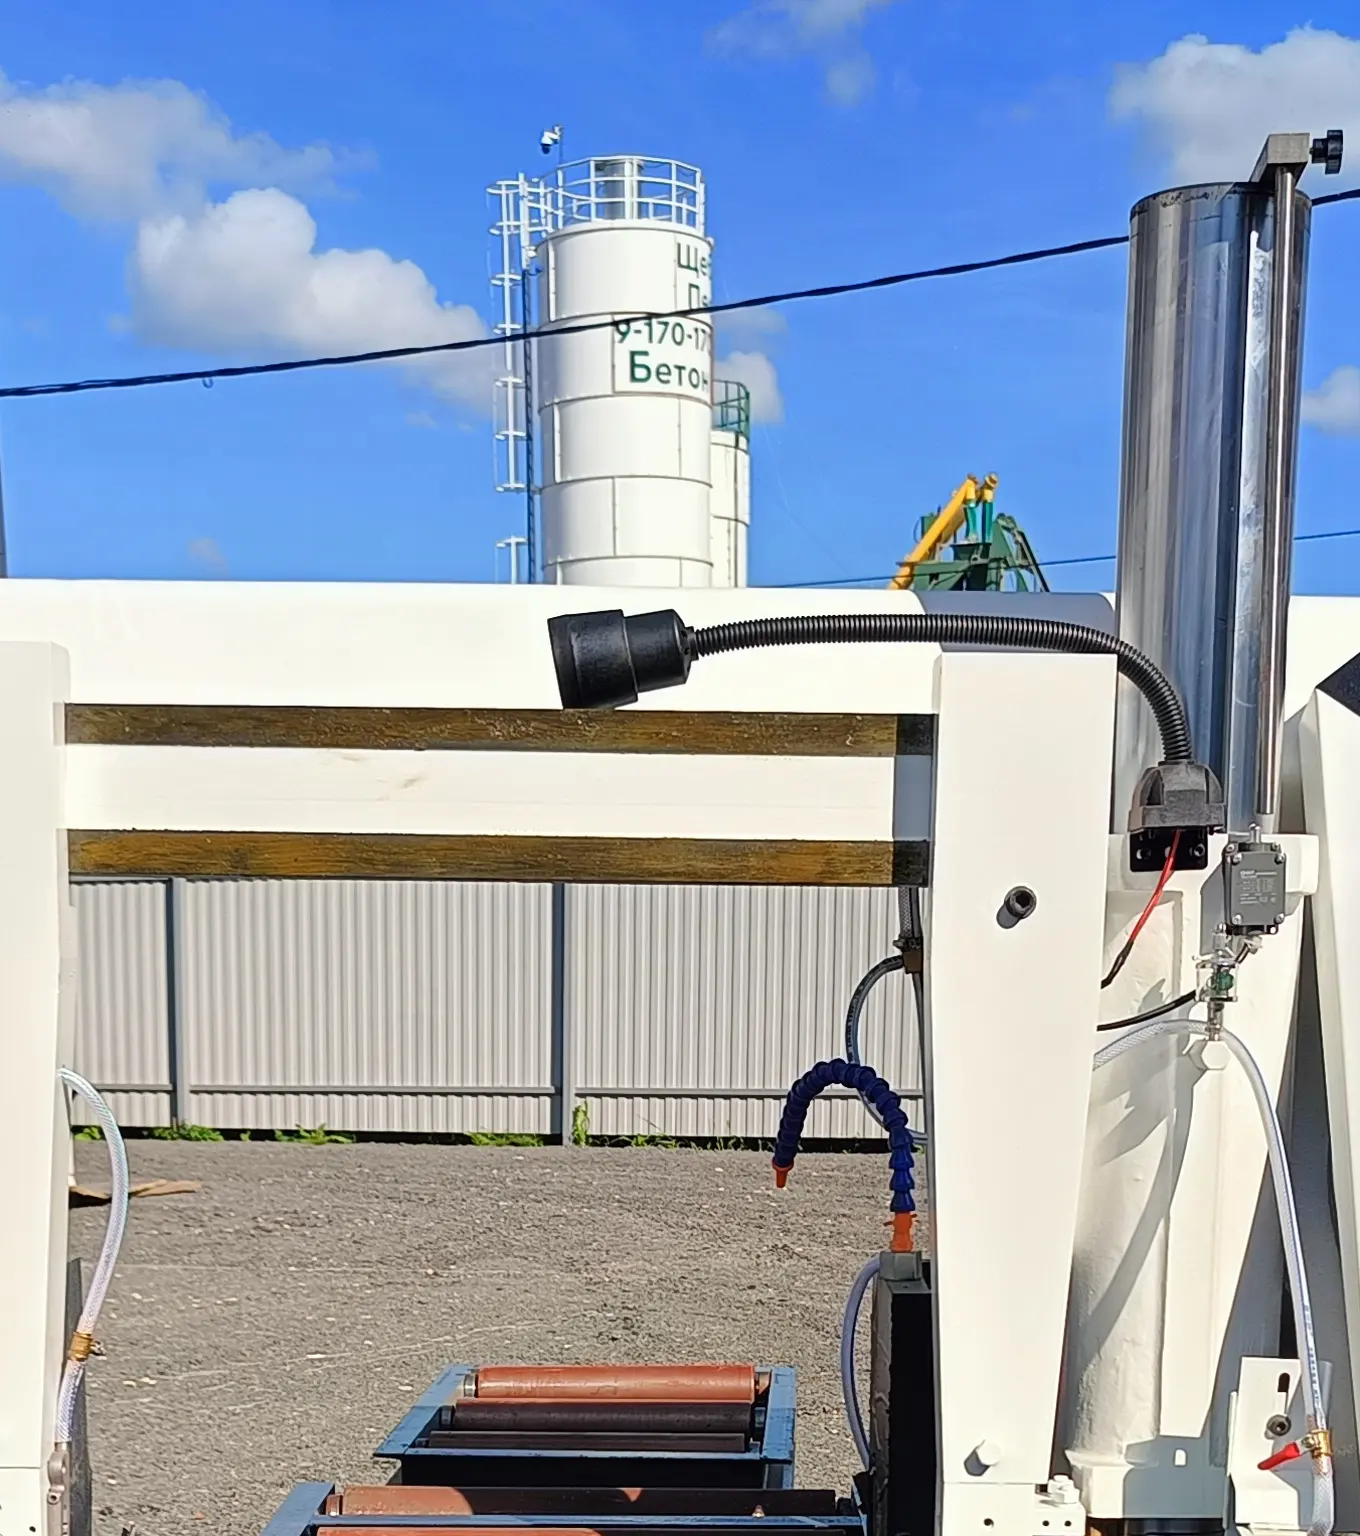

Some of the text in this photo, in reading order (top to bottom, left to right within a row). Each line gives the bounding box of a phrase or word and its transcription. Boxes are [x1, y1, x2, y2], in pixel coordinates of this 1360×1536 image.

[676, 242, 712, 280] Ще
[615, 315, 712, 352] 9-170-17
[629, 350, 709, 392] Бетон
